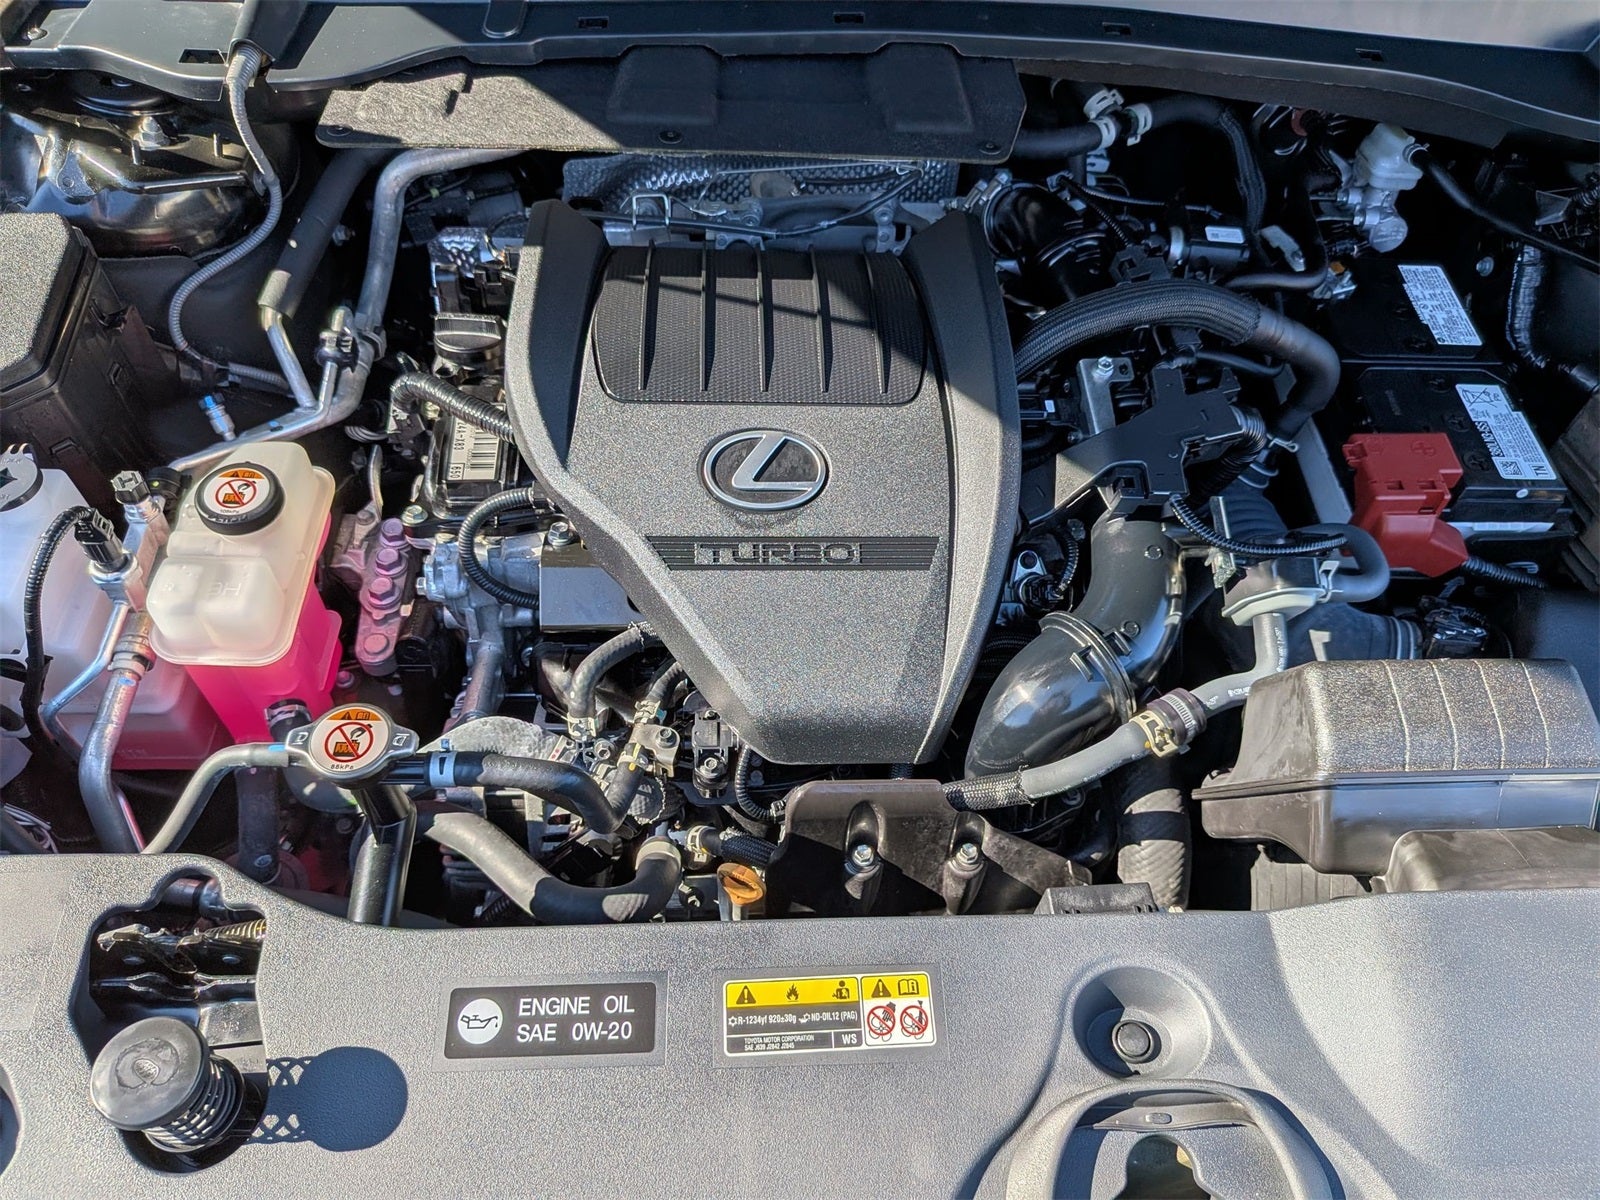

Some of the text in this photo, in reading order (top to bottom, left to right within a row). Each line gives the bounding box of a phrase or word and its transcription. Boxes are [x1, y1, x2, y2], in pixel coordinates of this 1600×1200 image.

[697, 542, 856, 564] TURBO
[518, 995, 635, 1016] ENGINE OIL
[737, 1014, 767, 1026] R-1234yf
[840, 1010, 858, 1022] (PAG)
[516, 1021, 632, 1043] SAE 0W-20
[781, 1034, 815, 1042] CORPORATION
[841, 1033, 858, 1045] WS
